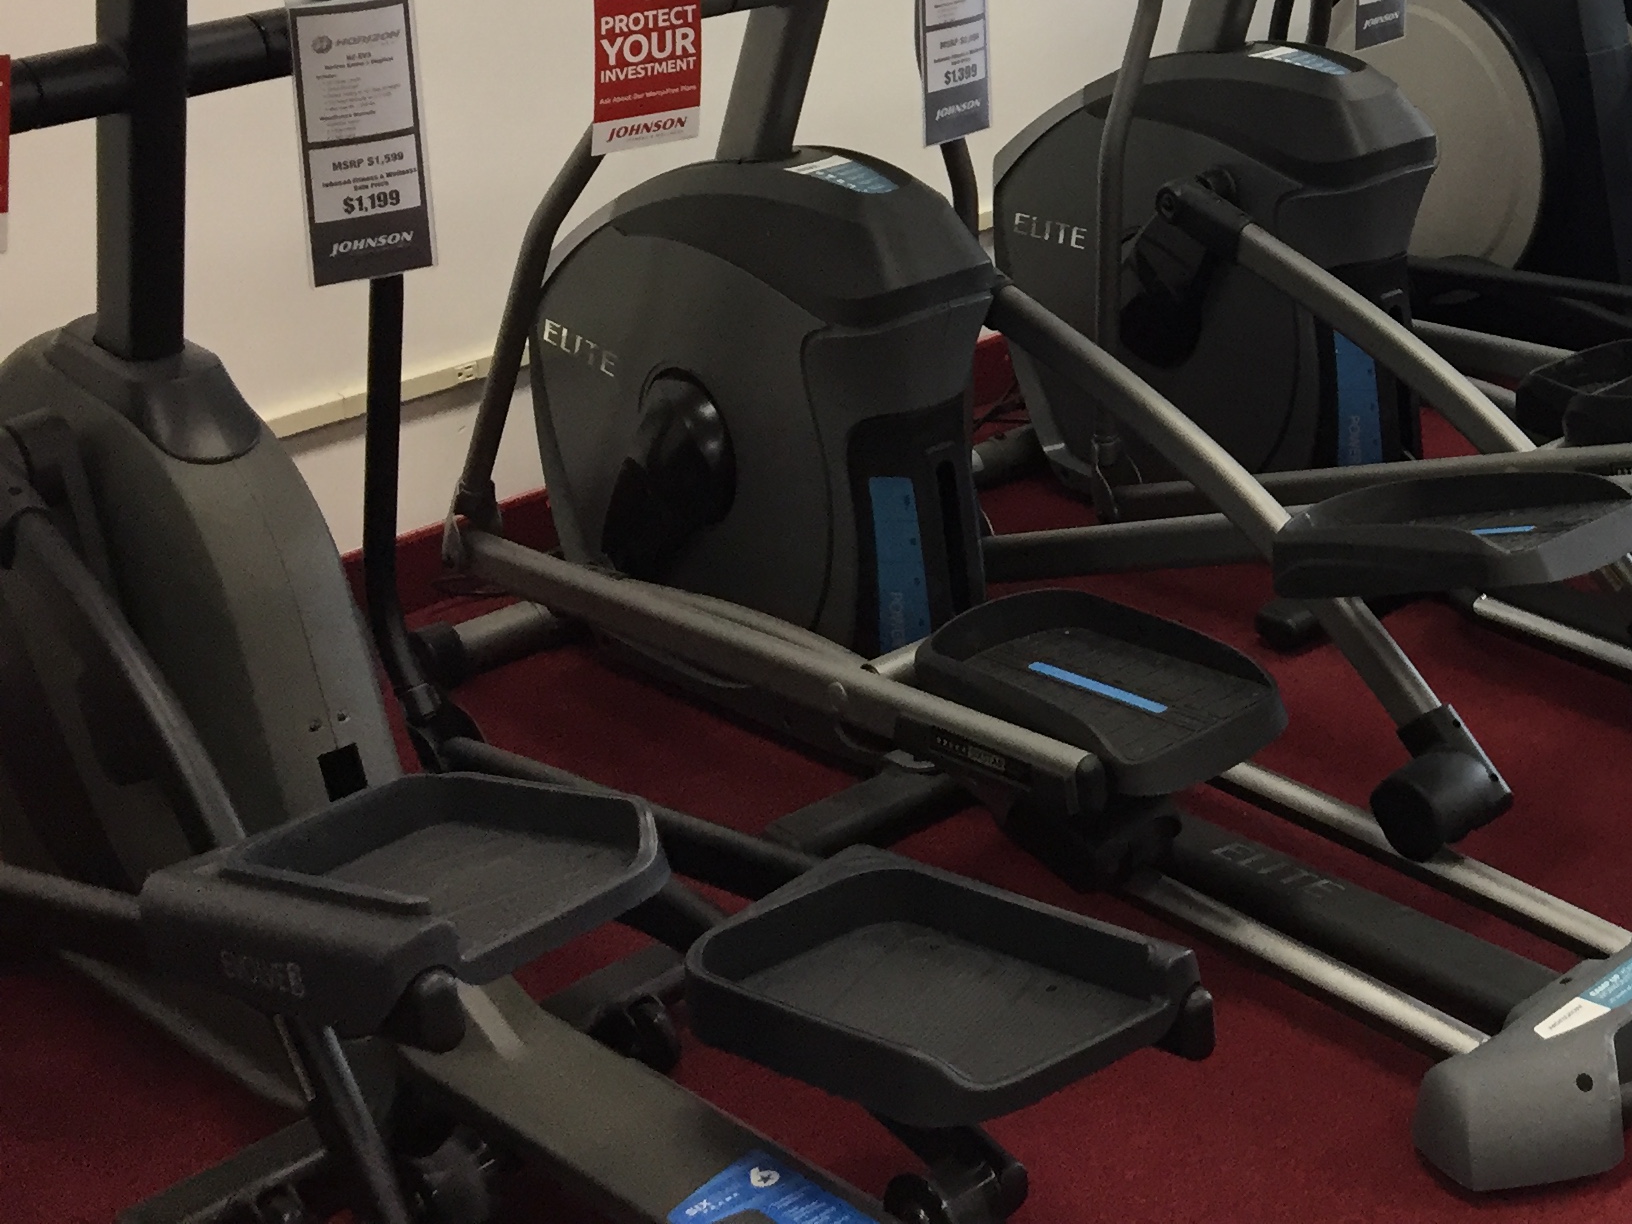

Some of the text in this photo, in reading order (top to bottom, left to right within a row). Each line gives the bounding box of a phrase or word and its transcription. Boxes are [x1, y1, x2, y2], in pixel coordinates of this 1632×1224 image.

[600, 4, 697, 35] PROTECT
[1363, 11, 1400, 30] JOHNSON
[335, 29, 401, 46] HORIZON
[600, 27, 697, 66] YOUR
[600, 56, 697, 83] INVESTMENT
[935, 98, 981, 122] JOHNSON
[607, 116, 688, 143] JOHNSON
[332, 151, 405, 171] MSRP $1,599
[343, 189, 401, 214] $1,199
[329, 230, 414, 258] JOHNSON
[1013, 212, 1088, 250] ELITE
[543, 318, 618, 377] ELITE
[1211, 843, 1346, 898] ELITE
